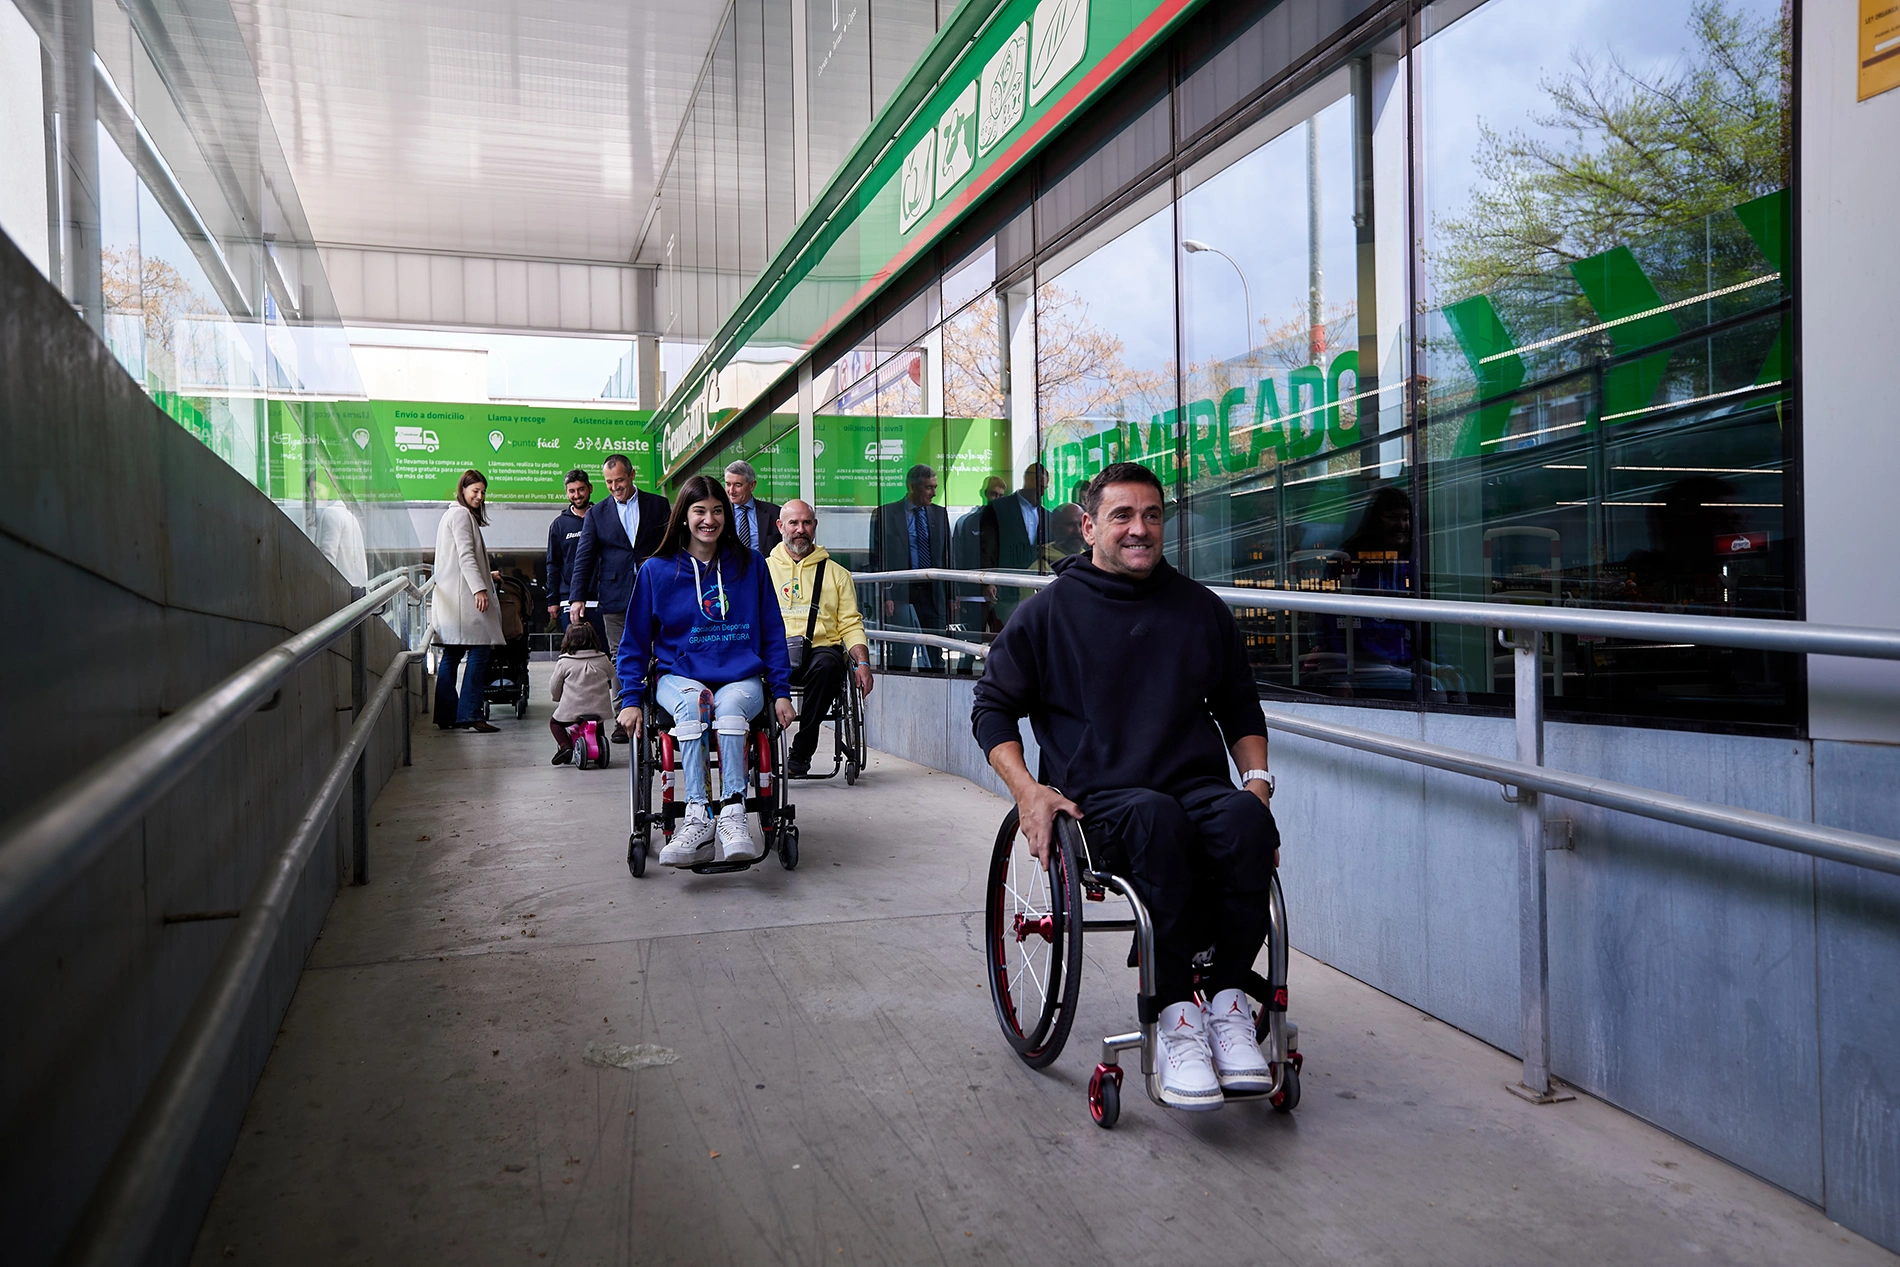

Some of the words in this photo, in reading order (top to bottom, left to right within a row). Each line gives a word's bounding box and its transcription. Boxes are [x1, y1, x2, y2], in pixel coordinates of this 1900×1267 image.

[427, 412, 465, 420] domicilio
[488, 414, 512, 422] Llama
[520, 416, 546, 424] recoge
[573, 416, 613, 425] Asistencia
[602, 437, 650, 451] Asiste
[722, 633, 750, 642] INTEGRA
